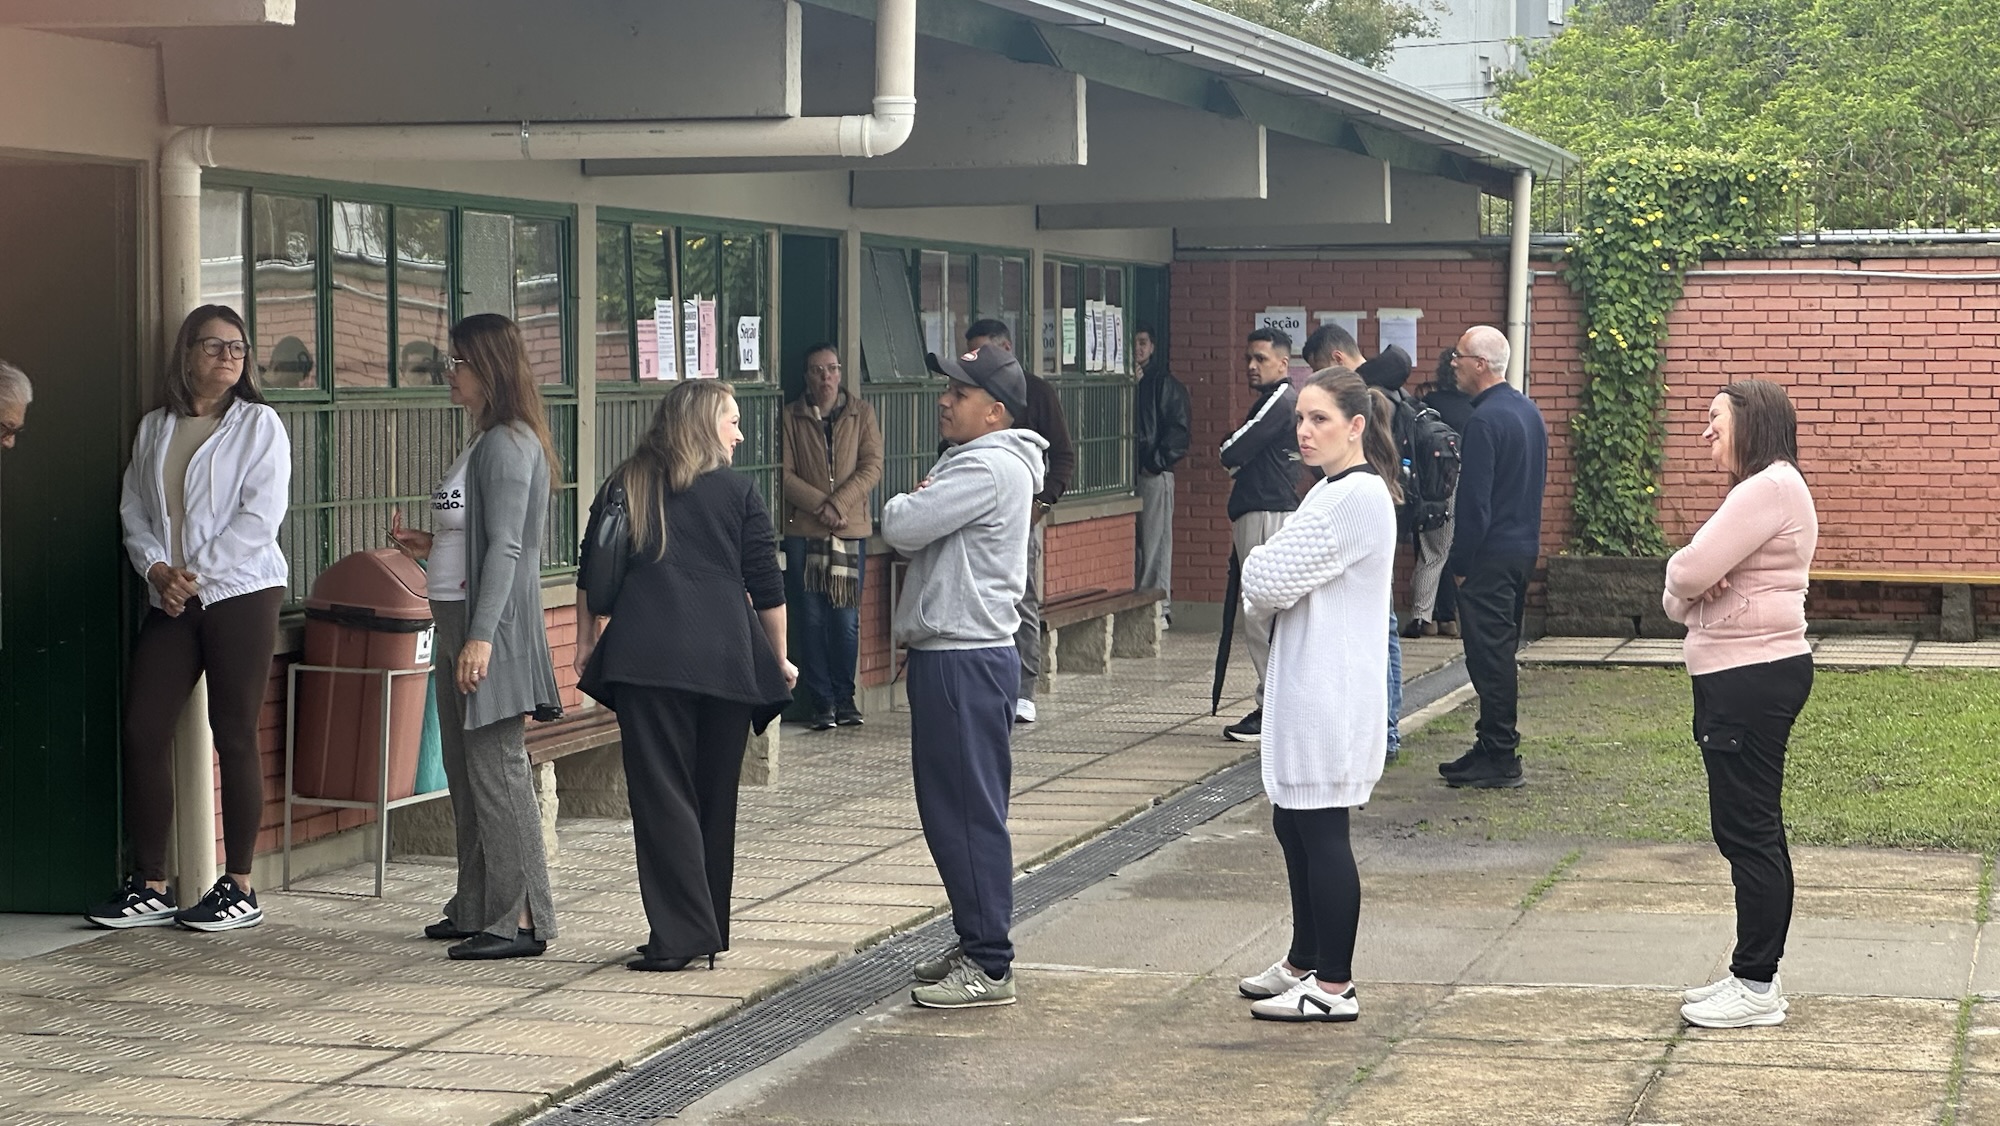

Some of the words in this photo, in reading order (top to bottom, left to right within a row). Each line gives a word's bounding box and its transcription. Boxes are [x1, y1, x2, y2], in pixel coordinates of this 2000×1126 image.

[1263, 316, 1300, 331] Seção
[740, 322, 757, 343] Seção
[451, 489, 461, 499] &
[964, 979, 987, 998] N
